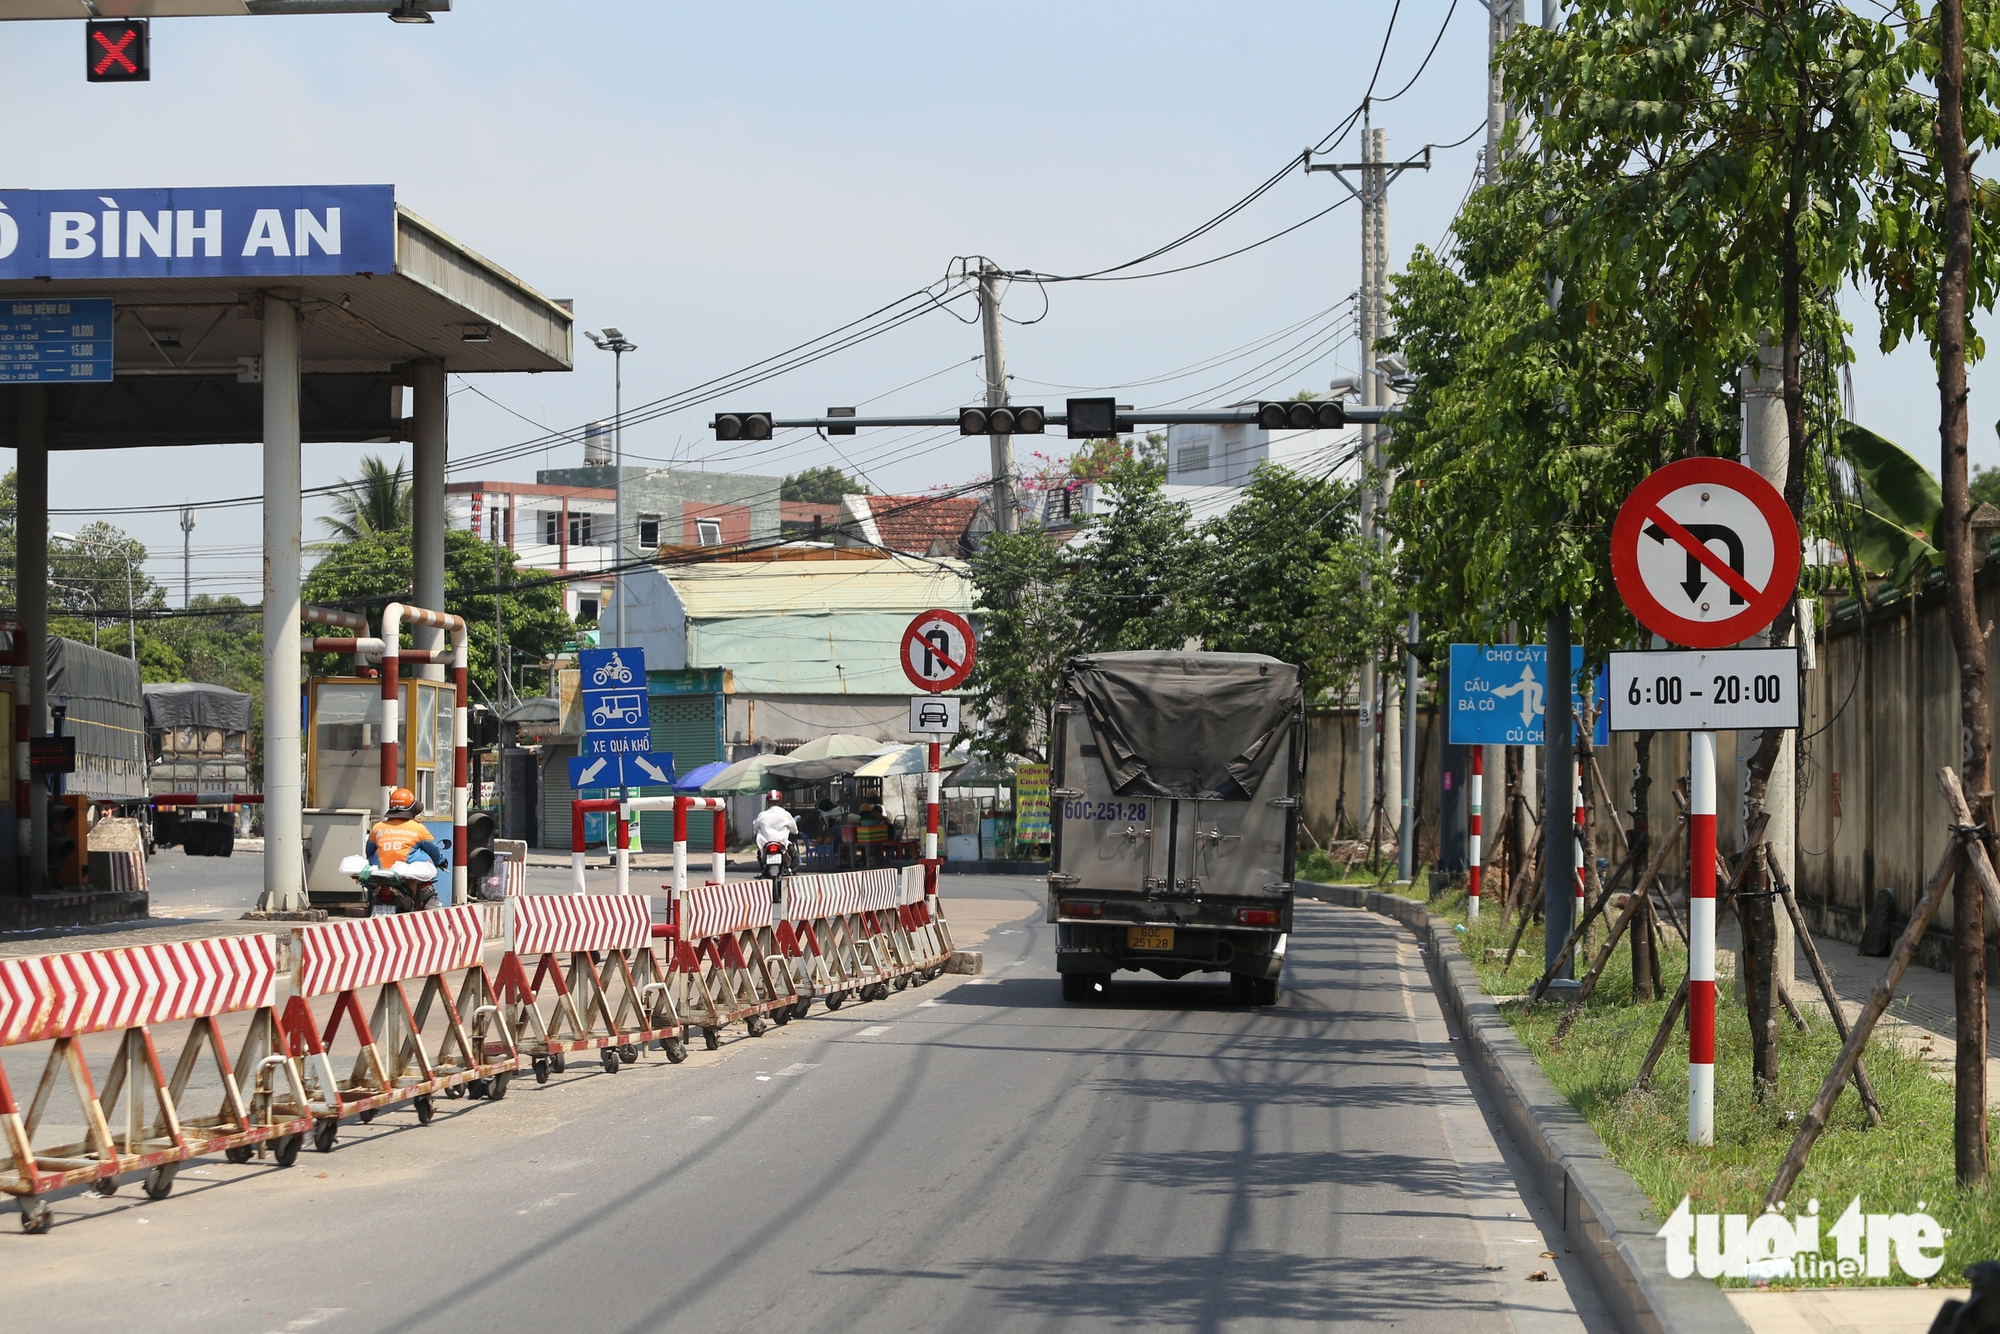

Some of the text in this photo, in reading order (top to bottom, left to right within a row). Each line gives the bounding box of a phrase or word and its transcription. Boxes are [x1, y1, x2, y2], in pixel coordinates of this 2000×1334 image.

[48, 196, 222, 259] BÌNH
[241, 206, 342, 257] AN
[71, 325, 94, 337] 10.000
[70, 344, 94, 357] 15.000
[70, 363, 94, 377] 20.000
[1486, 649, 1513, 664] CHỢ
[1515, 648, 1541, 662] CÂY
[1464, 676, 1490, 692] CẦU
[1628, 675, 1682, 706] 6:00
[1713, 674, 1781, 704] 20:00
[1458, 696, 1496, 711] BÀ CÔ
[1506, 726, 1545, 742] CỦ CH
[593, 732, 650, 753] XE QUÁ KHỔ
[1019, 767, 1042, 775] Coffee
[384, 828, 418, 838] Ahamove
[1140, 928, 1161, 938] 60C
[1132, 938, 1168, 949] 251.28
